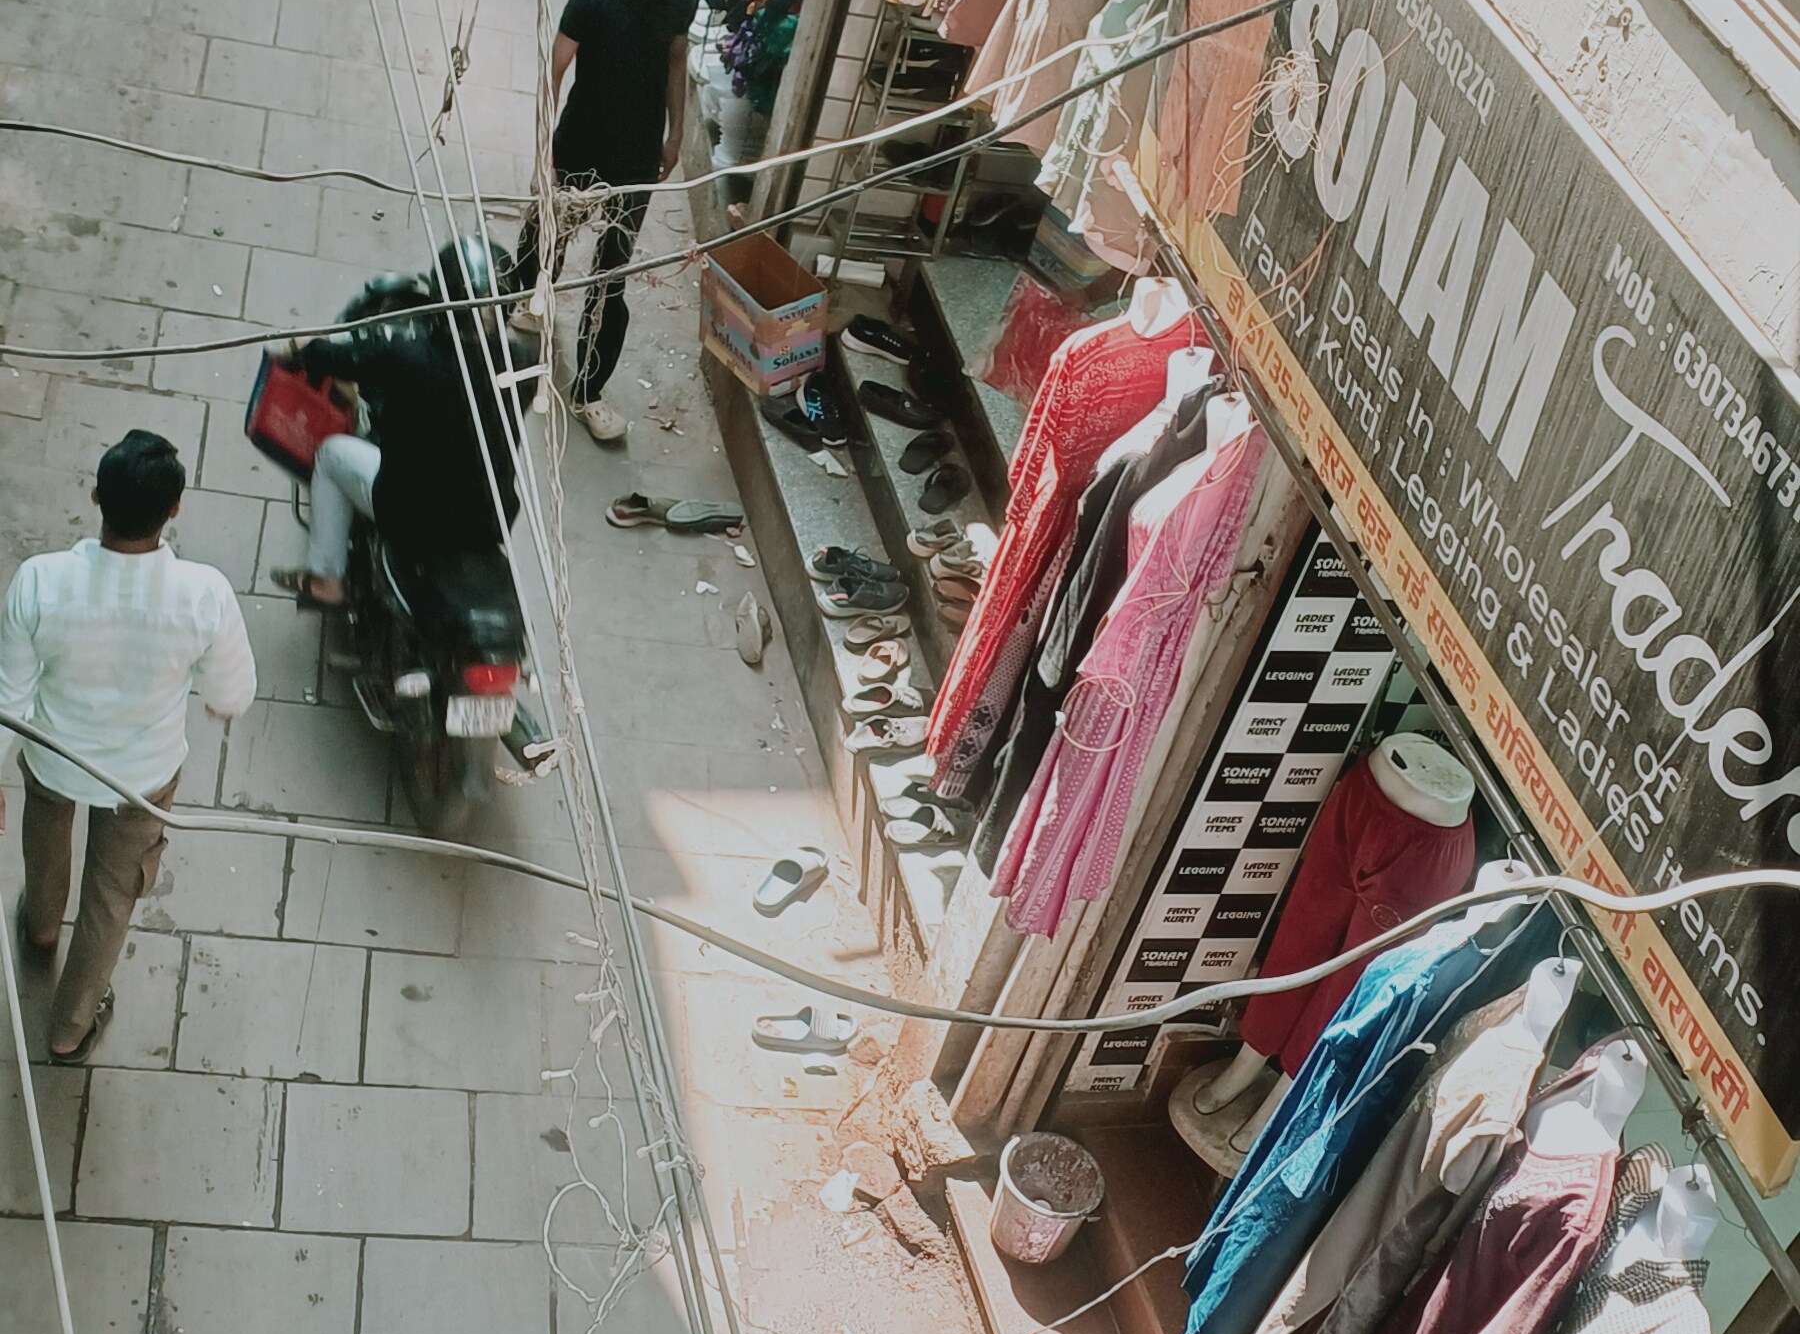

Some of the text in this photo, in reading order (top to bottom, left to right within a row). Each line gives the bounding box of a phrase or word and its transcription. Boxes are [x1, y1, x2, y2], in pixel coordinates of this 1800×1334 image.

[1604, 243, 1655, 336] Mob.
[1673, 331, 1800, 523] 630734673
[1245, 215, 1315, 338] Fancy
[1316, 324, 1382, 455] Kurti,
[1390, 436, 1502, 630] Legging
[1506, 622, 1535, 680] &
[1537, 669, 1650, 853] Ladies
[1331, 276, 1403, 402] Deals
[1407, 388, 1435, 453] In
[1459, 461, 1630, 732] Wholesaler
[1634, 742, 1682, 805] of
[1296, 614, 1335, 623] LADIES
[1294, 624, 1328, 633] ITEMS
[1265, 671, 1314, 681] LEGGING
[1333, 667, 1372, 677] LADIES
[1331, 677, 1365, 686] ITEMS
[1250, 718, 1287, 727] FANCY
[1247, 727, 1281, 736] KURTI
[1303, 723, 1350, 732] LEGGING
[1222, 767, 1271, 778] SONAM
[1288, 768, 1324, 776] FANCY
[1315, 424, 1357, 500] सूरज
[1397, 550, 1429, 610] नई
[1486, 693, 1583, 859] धोबियाना
[1643, 947, 1750, 1124] वाराणसी
[1284, 777, 1318, 786] KURTI
[1206, 816, 1244, 824] LADIES
[1259, 817, 1307, 827] SONAM
[1204, 825, 1237, 833] ITEMS
[1178, 866, 1225, 875] LEGGING
[1243, 862, 1281, 870] LADIES
[1242, 871, 1274, 879] ITEMS
[1166, 907, 1201, 915] FANCY
[1216, 911, 1262, 919] LEGGING
[1141, 951, 1188, 960] SONAM
[1204, 951, 1238, 959] FANCY
[1201, 959, 1233, 967] KURTI
[1127, 995, 1163, 1003] LADIES
[1103, 1040, 1147, 1049] LEGGING
